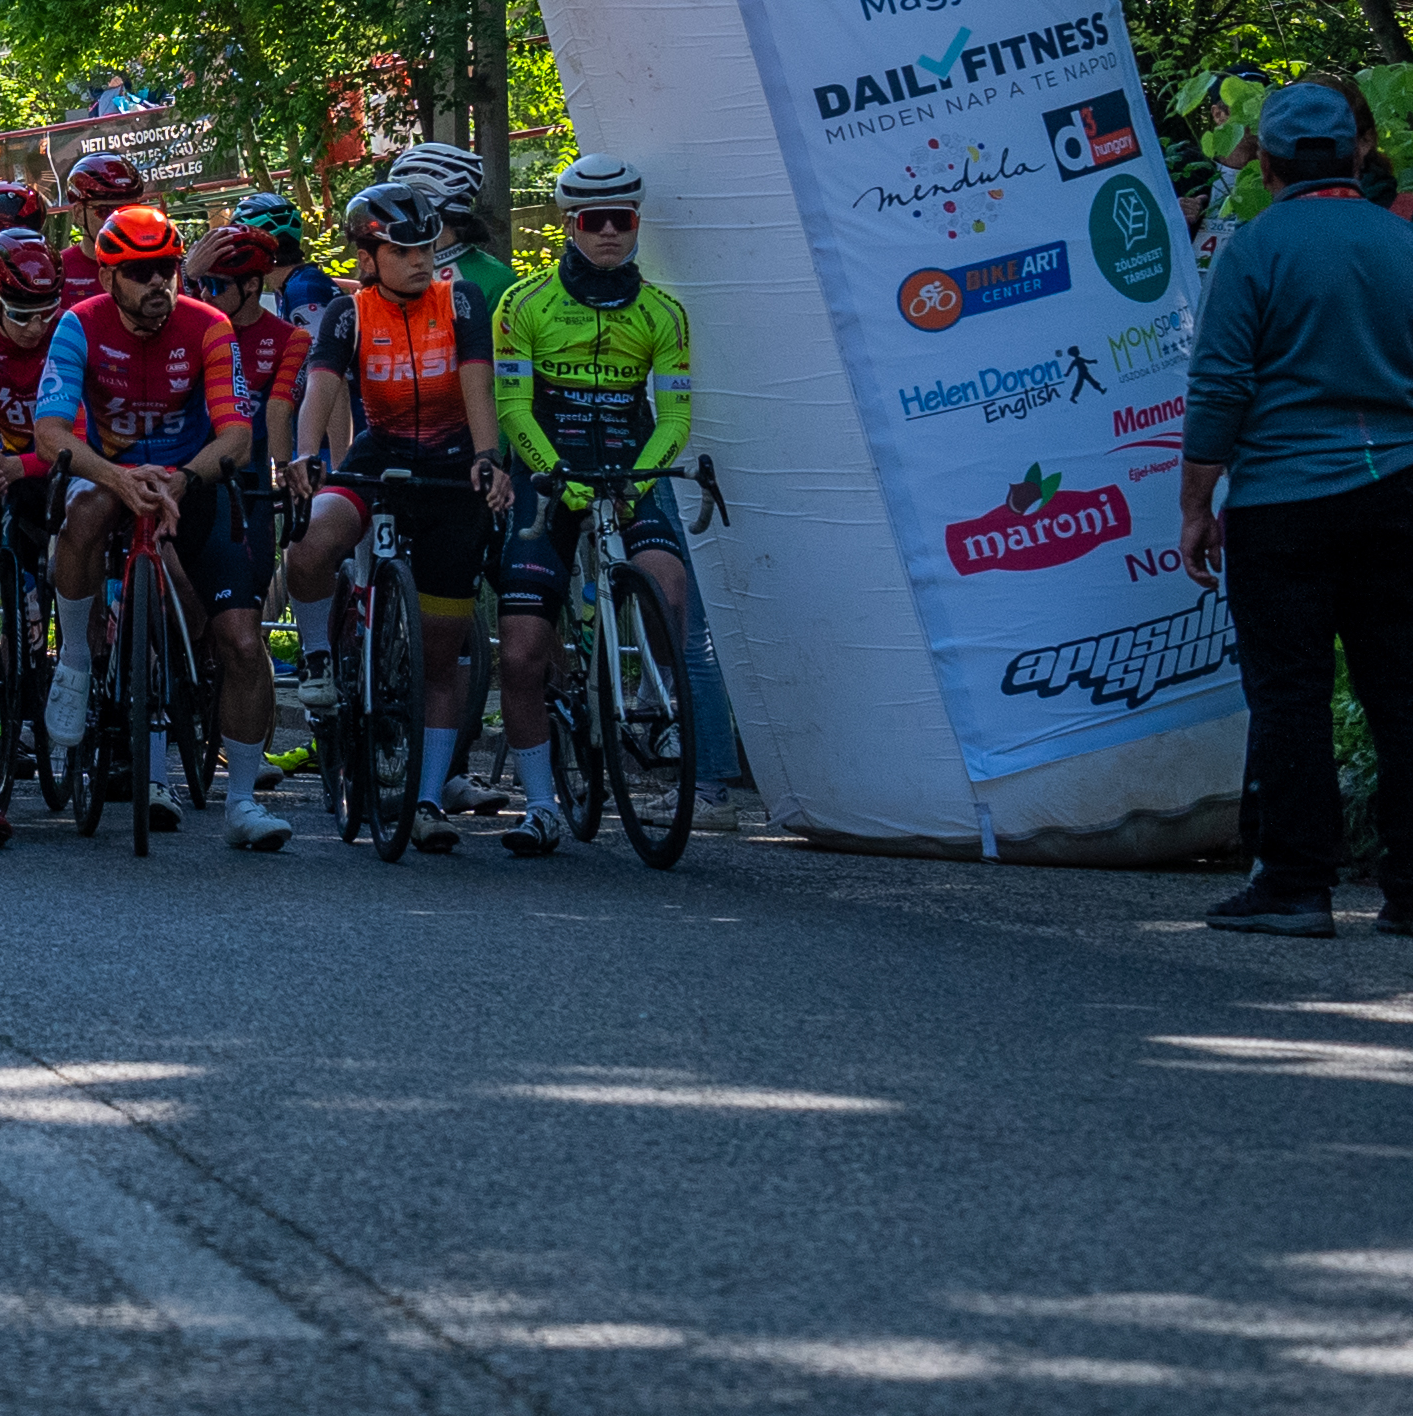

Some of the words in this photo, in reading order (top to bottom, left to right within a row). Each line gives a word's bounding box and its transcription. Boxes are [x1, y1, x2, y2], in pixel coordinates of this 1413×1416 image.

[959, 11, 1110, 84] FITNESS
[824, 101, 936, 146] MINDEN
[955, 87, 998, 112] NAP
[1008, 81, 1026, 100] A
[1034, 70, 1061, 92] TE
[1064, 51, 1119, 82] NAPOD
[81, 137, 107, 155] HETI
[107, 134, 122, 151] 50
[1091, 128, 1135, 158] hungary
[151, 159, 203, 181] RÉSZLEG
[852, 146, 1047, 213] mendula
[981, 278, 1043, 305] CENTER
[1122, 263, 1164, 285] TÁRSULÁS
[541, 357, 641, 379] epronex
[898, 377, 980, 417] Helen
[978, 355, 1064, 398] Doron
[982, 383, 1063, 424] English
[1112, 395, 1185, 438] Manna
[962, 492, 1119, 562] maroni
[1090, 626, 1240, 710] spor
